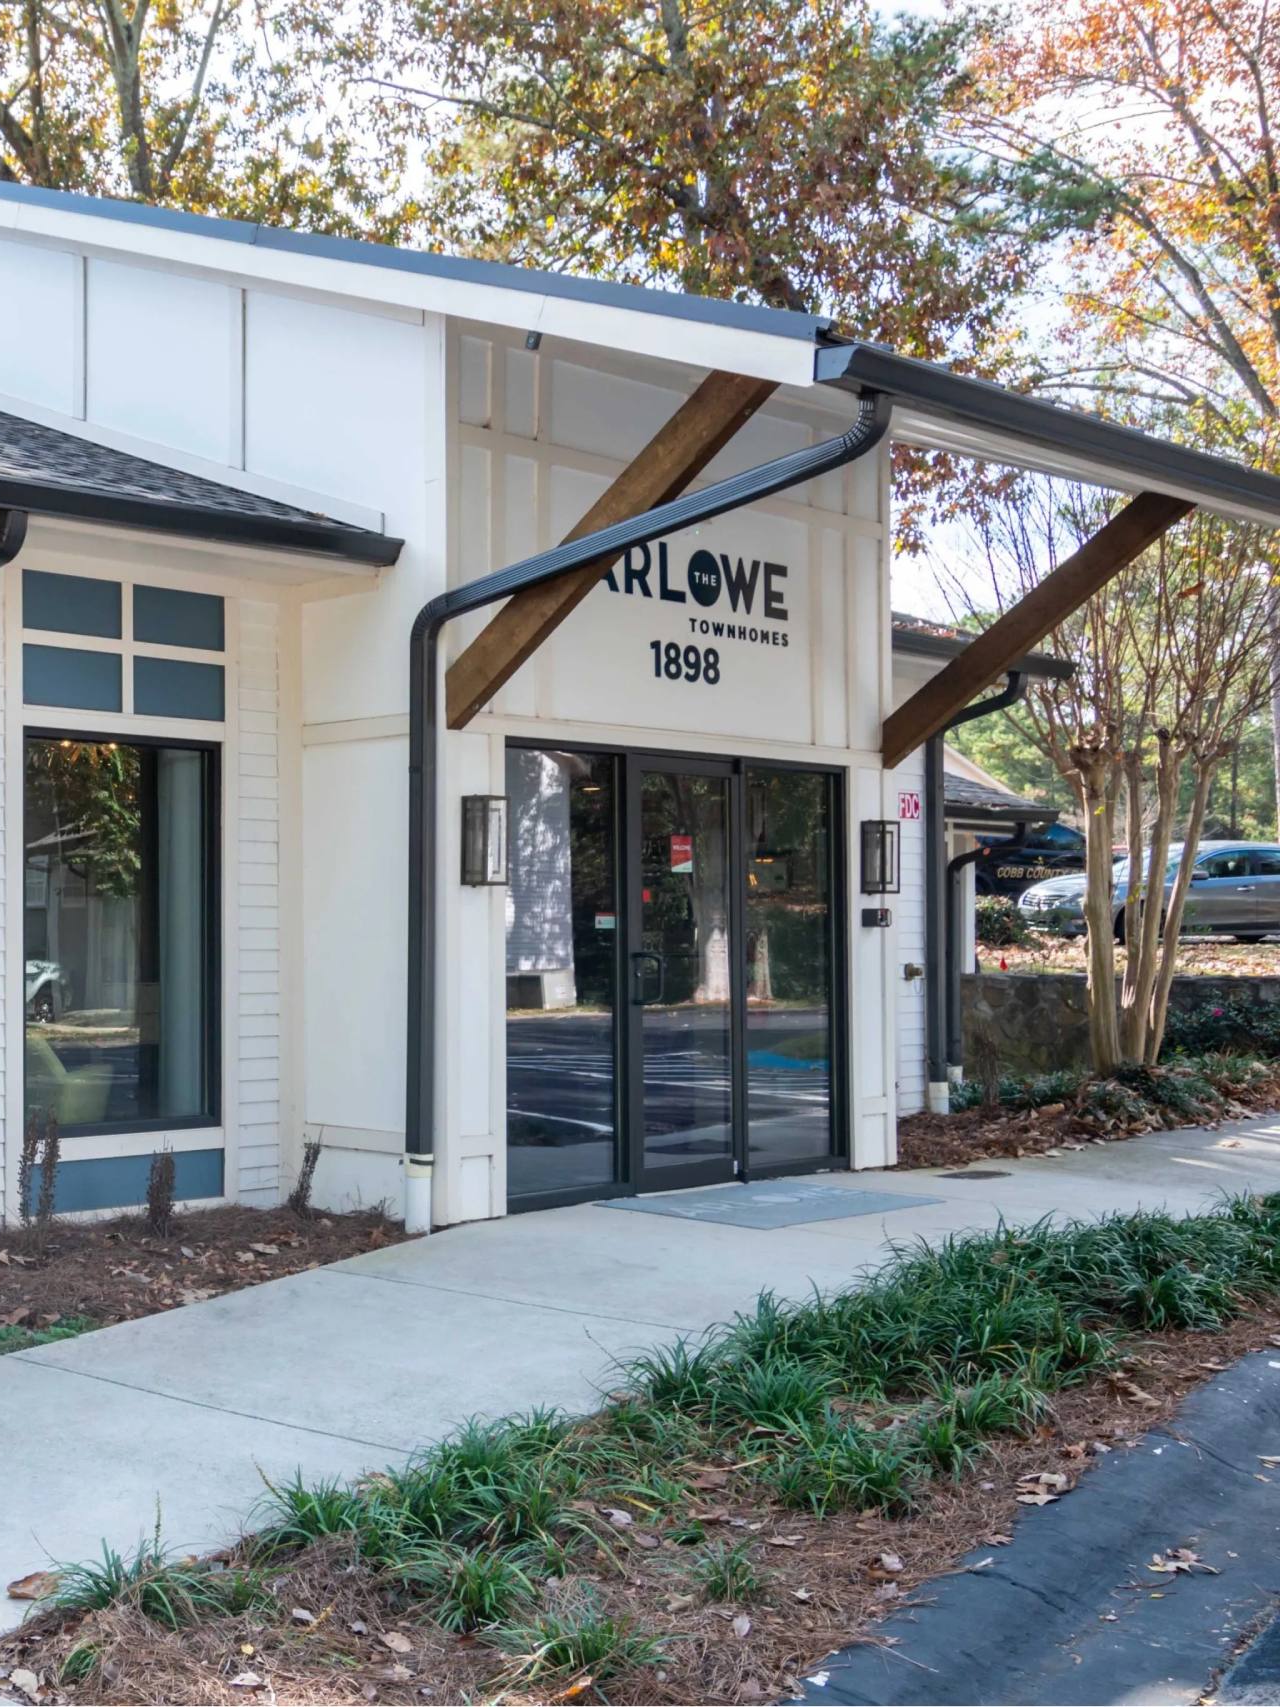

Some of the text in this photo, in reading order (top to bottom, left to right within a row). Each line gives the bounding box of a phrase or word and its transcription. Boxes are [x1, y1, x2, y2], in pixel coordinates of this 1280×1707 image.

[694, 571, 717, 587] THE
[689, 617, 789, 647] TOWNHOMES
[650, 640, 720, 685] 1898
[899, 793, 919, 818] FDC
[997, 866, 1024, 879] COBB
